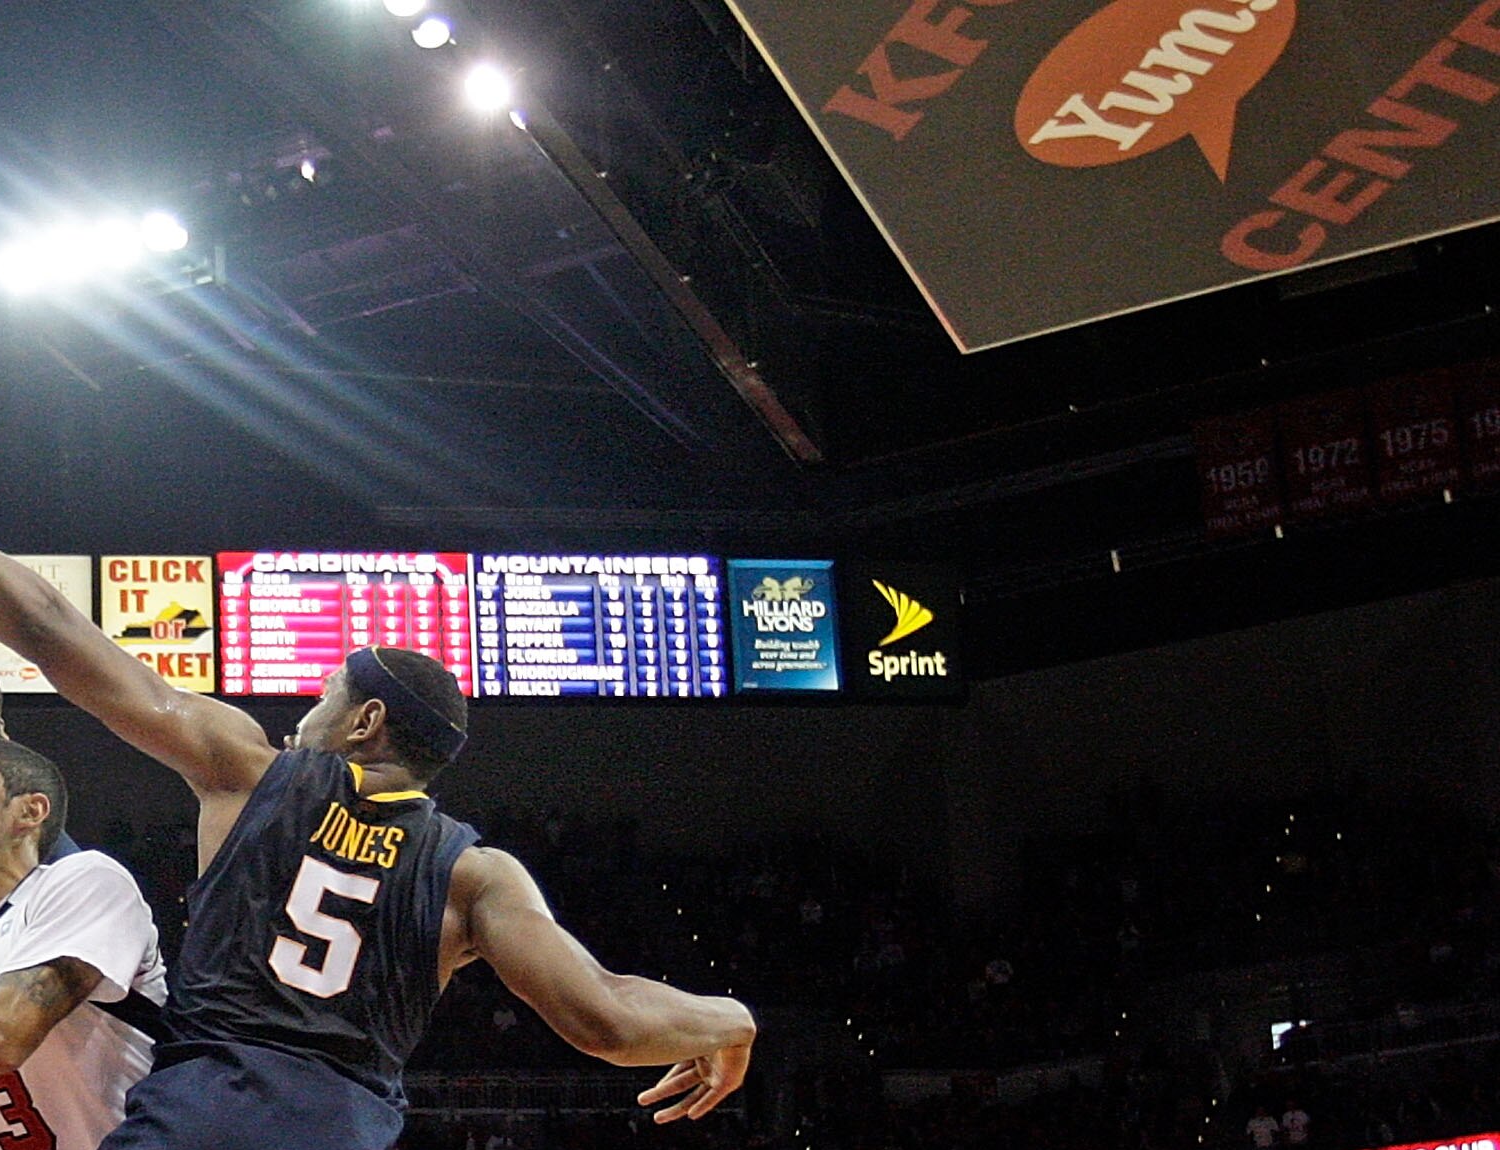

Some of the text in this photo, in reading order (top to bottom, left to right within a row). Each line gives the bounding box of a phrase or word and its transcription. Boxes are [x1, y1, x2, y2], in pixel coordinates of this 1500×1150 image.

[822, 0, 1012, 141] KF
[1380, 418, 1450, 457] 1975
[1294, 437, 1360, 474] 1972
[109, 560, 205, 583] CLICK
[253, 553, 436, 572] CARDINALS
[483, 556, 708, 574] MOUNTAINEERS
[120, 589, 148, 612] IT
[742, 600, 825, 617] HILLIARD
[152, 620, 186, 639] or
[251, 616, 286, 629] SIVA
[757, 617, 814, 632] LYONS
[507, 633, 564, 647] PEPPER
[507, 649, 578, 663] FLOWERS
[869, 650, 947, 682] Sprint
[310, 802, 405, 869] JONES
[268, 854, 380, 999] 5
